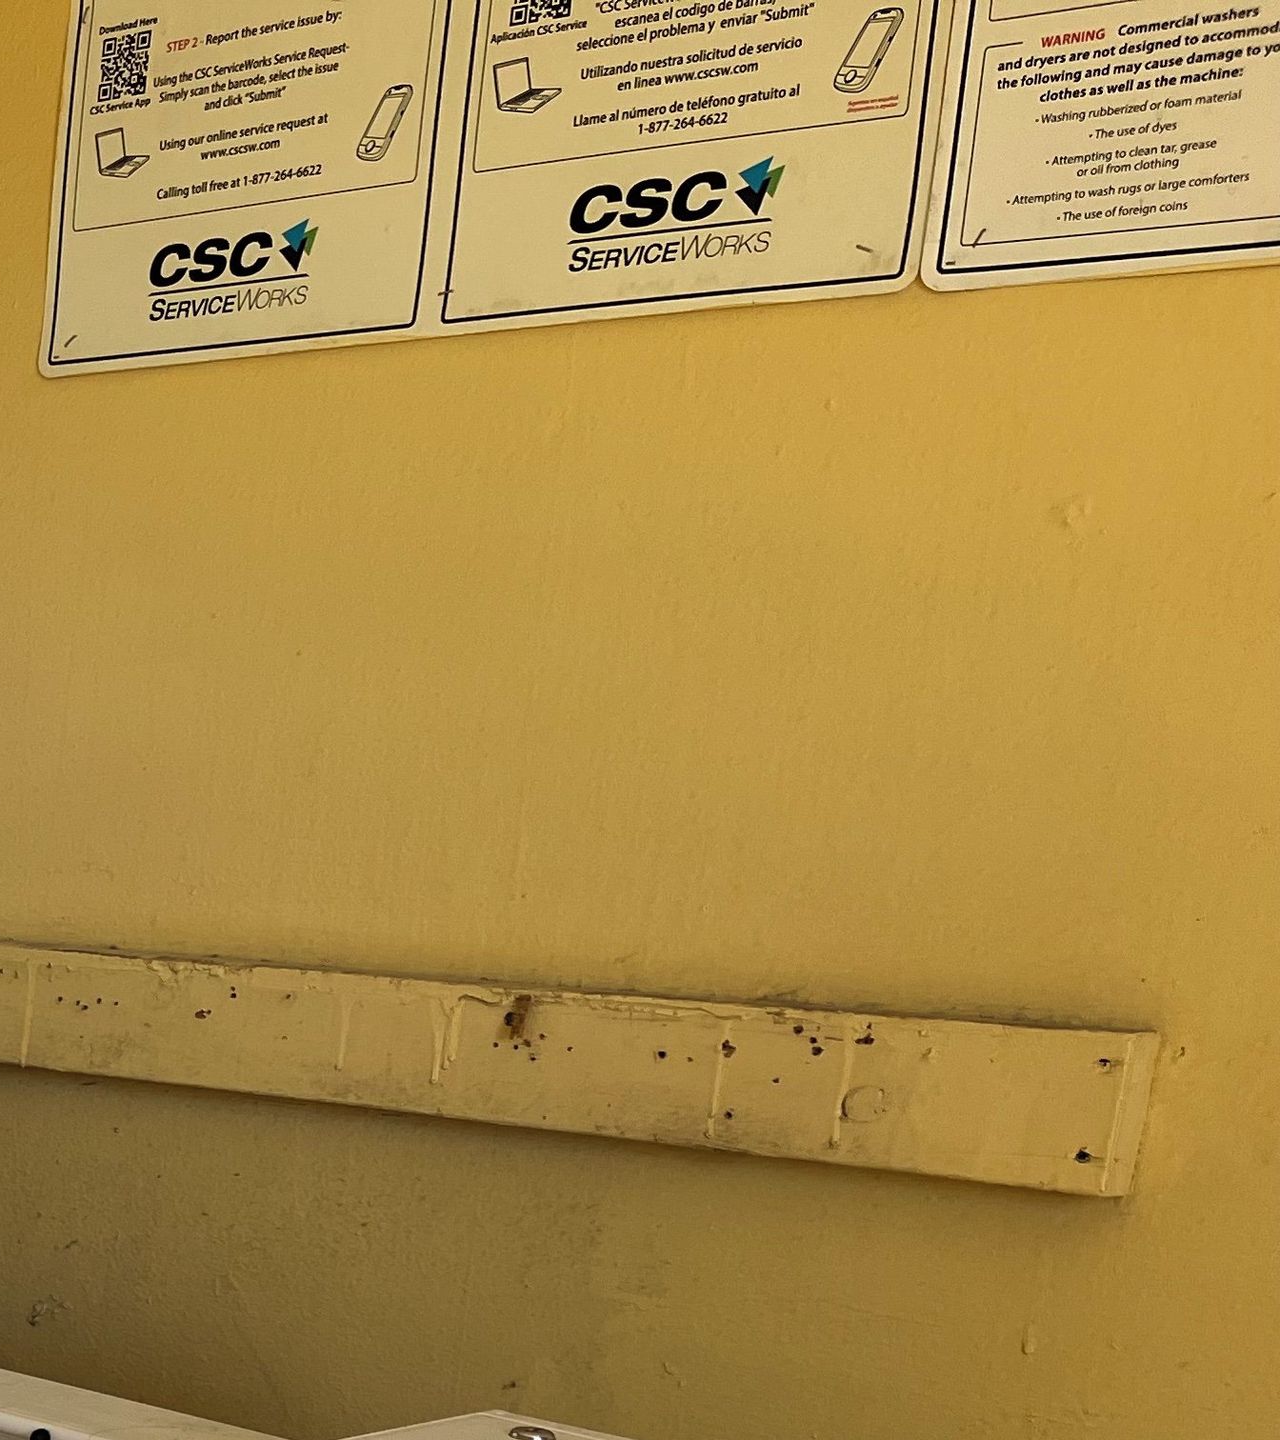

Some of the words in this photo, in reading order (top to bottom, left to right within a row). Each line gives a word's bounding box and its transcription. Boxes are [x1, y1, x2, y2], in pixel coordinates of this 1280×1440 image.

[98, 18, 139, 35] Download
[138, 17, 158, 27] Here
[166, 38, 191, 53] STEP
[191, 36, 199, 49] 2
[205, 29, 240, 46] Report
[241, 26, 258, 39] the
[259, 19, 296, 35] service
[296, 14, 324, 28] issue
[325, 10, 343, 24] by:
[536, 23, 555, 36] CSC
[555, 19, 588, 33] Service
[576, 33, 635, 52] seleccione
[636, 27, 648, 42] el
[649, 22, 706, 44] problema
[707, 20, 716, 35] y
[720, 13, 759, 29] enviar
[614, 12, 660, 29] escanea
[662, 6, 674, 21] el
[675, 2, 716, 19] codigo
[717, 0, 734, 12] de
[1041, 28, 1106, 48] WARNING
[1117, 13, 1200, 37] Commercial
[1201, 7, 1260, 25] washers
[580, 60, 638, 80] Utilizando
[640, 56, 684, 71] nuestra
[685, 44, 737, 65] solicitud
[738, 42, 754, 56] de
[756, 36, 803, 54] servicio
[997, 57, 1023, 72] and
[1024, 54, 1067, 69] dryers
[1068, 51, 1091, 62] are
[1092, 45, 1116, 59] not
[1118, 34, 1182, 56] designed
[1184, 35, 1200, 46] to
[1201, 20, 1280, 44] accommod
[153, 75, 178, 88] Using
[178, 71, 194, 83] the
[194, 66, 213, 80] CSC
[212, 55, 272, 77] ServiceWorks
[273, 50, 307, 66] Service
[158, 87, 189, 104] Simply
[189, 85, 210, 98] scan
[210, 80, 227, 94] the
[227, 73, 267, 91] barcode,
[268, 68, 296, 83] select
[297, 65, 314, 78] the
[314, 62, 339, 75] issue
[617, 80, 632, 92] en
[664, 62, 759, 85] www.cscsw.com
[997, 77, 1019, 90] the
[1020, 69, 1083, 87] following
[1084, 63, 1111, 79] and
[1112, 62, 1143, 75] may
[1144, 56, 1184, 71] cause
[1186, 48, 1244, 65] damage
[1246, 45, 1262, 57] to
[1039, 87, 1087, 103] clothes
[1088, 86, 1104, 96] as
[1106, 79, 1135, 94] well
[1136, 79, 1151, 91] as
[1154, 74, 1177, 88] the
[1179, 67, 1244, 85] machine:
[89, 104, 106, 116] CSC
[105, 100, 134, 113] Service
[134, 98, 151, 109] App
[204, 96, 222, 111] and
[222, 93, 243, 108] click
[573, 113, 608, 128] Llame
[608, 108, 620, 122] al
[621, 105, 667, 121] número
[668, 100, 684, 114] de
[686, 95, 736, 112] teléfono
[737, 87, 787, 107] gratuito
[788, 83, 801, 97] al
[1041, 110, 1086, 124] Washing
[1088, 99, 1149, 119] rubberized
[1149, 101, 1163, 111] or
[1163, 97, 1193, 109] foam
[1194, 88, 1243, 105] material
[159, 138, 187, 151] Using
[187, 135, 206, 147] our
[206, 129, 238, 144] online
[239, 122, 275, 138] service
[276, 115, 316, 132] request
[317, 112, 329, 125] at
[638, 111, 728, 135] 1-877-264-6622
[1095, 128, 1115, 139] The
[1116, 127, 1136, 137] use
[1137, 122, 1151, 135] of
[1151, 121, 1177, 135] dyes
[200, 139, 281, 160] www.cscsw.com
[1051, 151, 1113, 166] Attempting
[1114, 149, 1127, 159] to
[1128, 145, 1158, 158] clean
[1160, 144, 1178, 154] tar,
[1179, 139, 1218, 155] grease
[1076, 168, 1089, 177] or
[1090, 164, 1104, 176] oil
[1105, 162, 1132, 174] from
[1133, 158, 1180, 171] clothing
[156, 186, 190, 200] Calling
[191, 181, 208, 195] toll
[209, 179, 229, 192] free
[230, 177, 241, 189] at
[243, 163, 322, 187] 1-877-264-6622
[1011, 191, 1072, 206] Attempting
[1074, 190, 1086, 199] to
[1087, 184, 1116, 198] wash
[1117, 184, 1142, 197] rugs
[1143, 182, 1156, 192] or
[1158, 179, 1187, 192] large
[1188, 172, 1250, 188] comforters
[569, 171, 727, 234] CSC
[1062, 210, 1082, 222] The
[1084, 210, 1103, 220] use
[1104, 206, 1118, 218] of
[1117, 204, 1157, 217] foreign
[1159, 201, 1188, 213] coins
[149, 231, 273, 288] CSC
[568, 231, 772, 273] SERVICEWORKS
[149, 286, 308, 322] SERVICEWORKS
